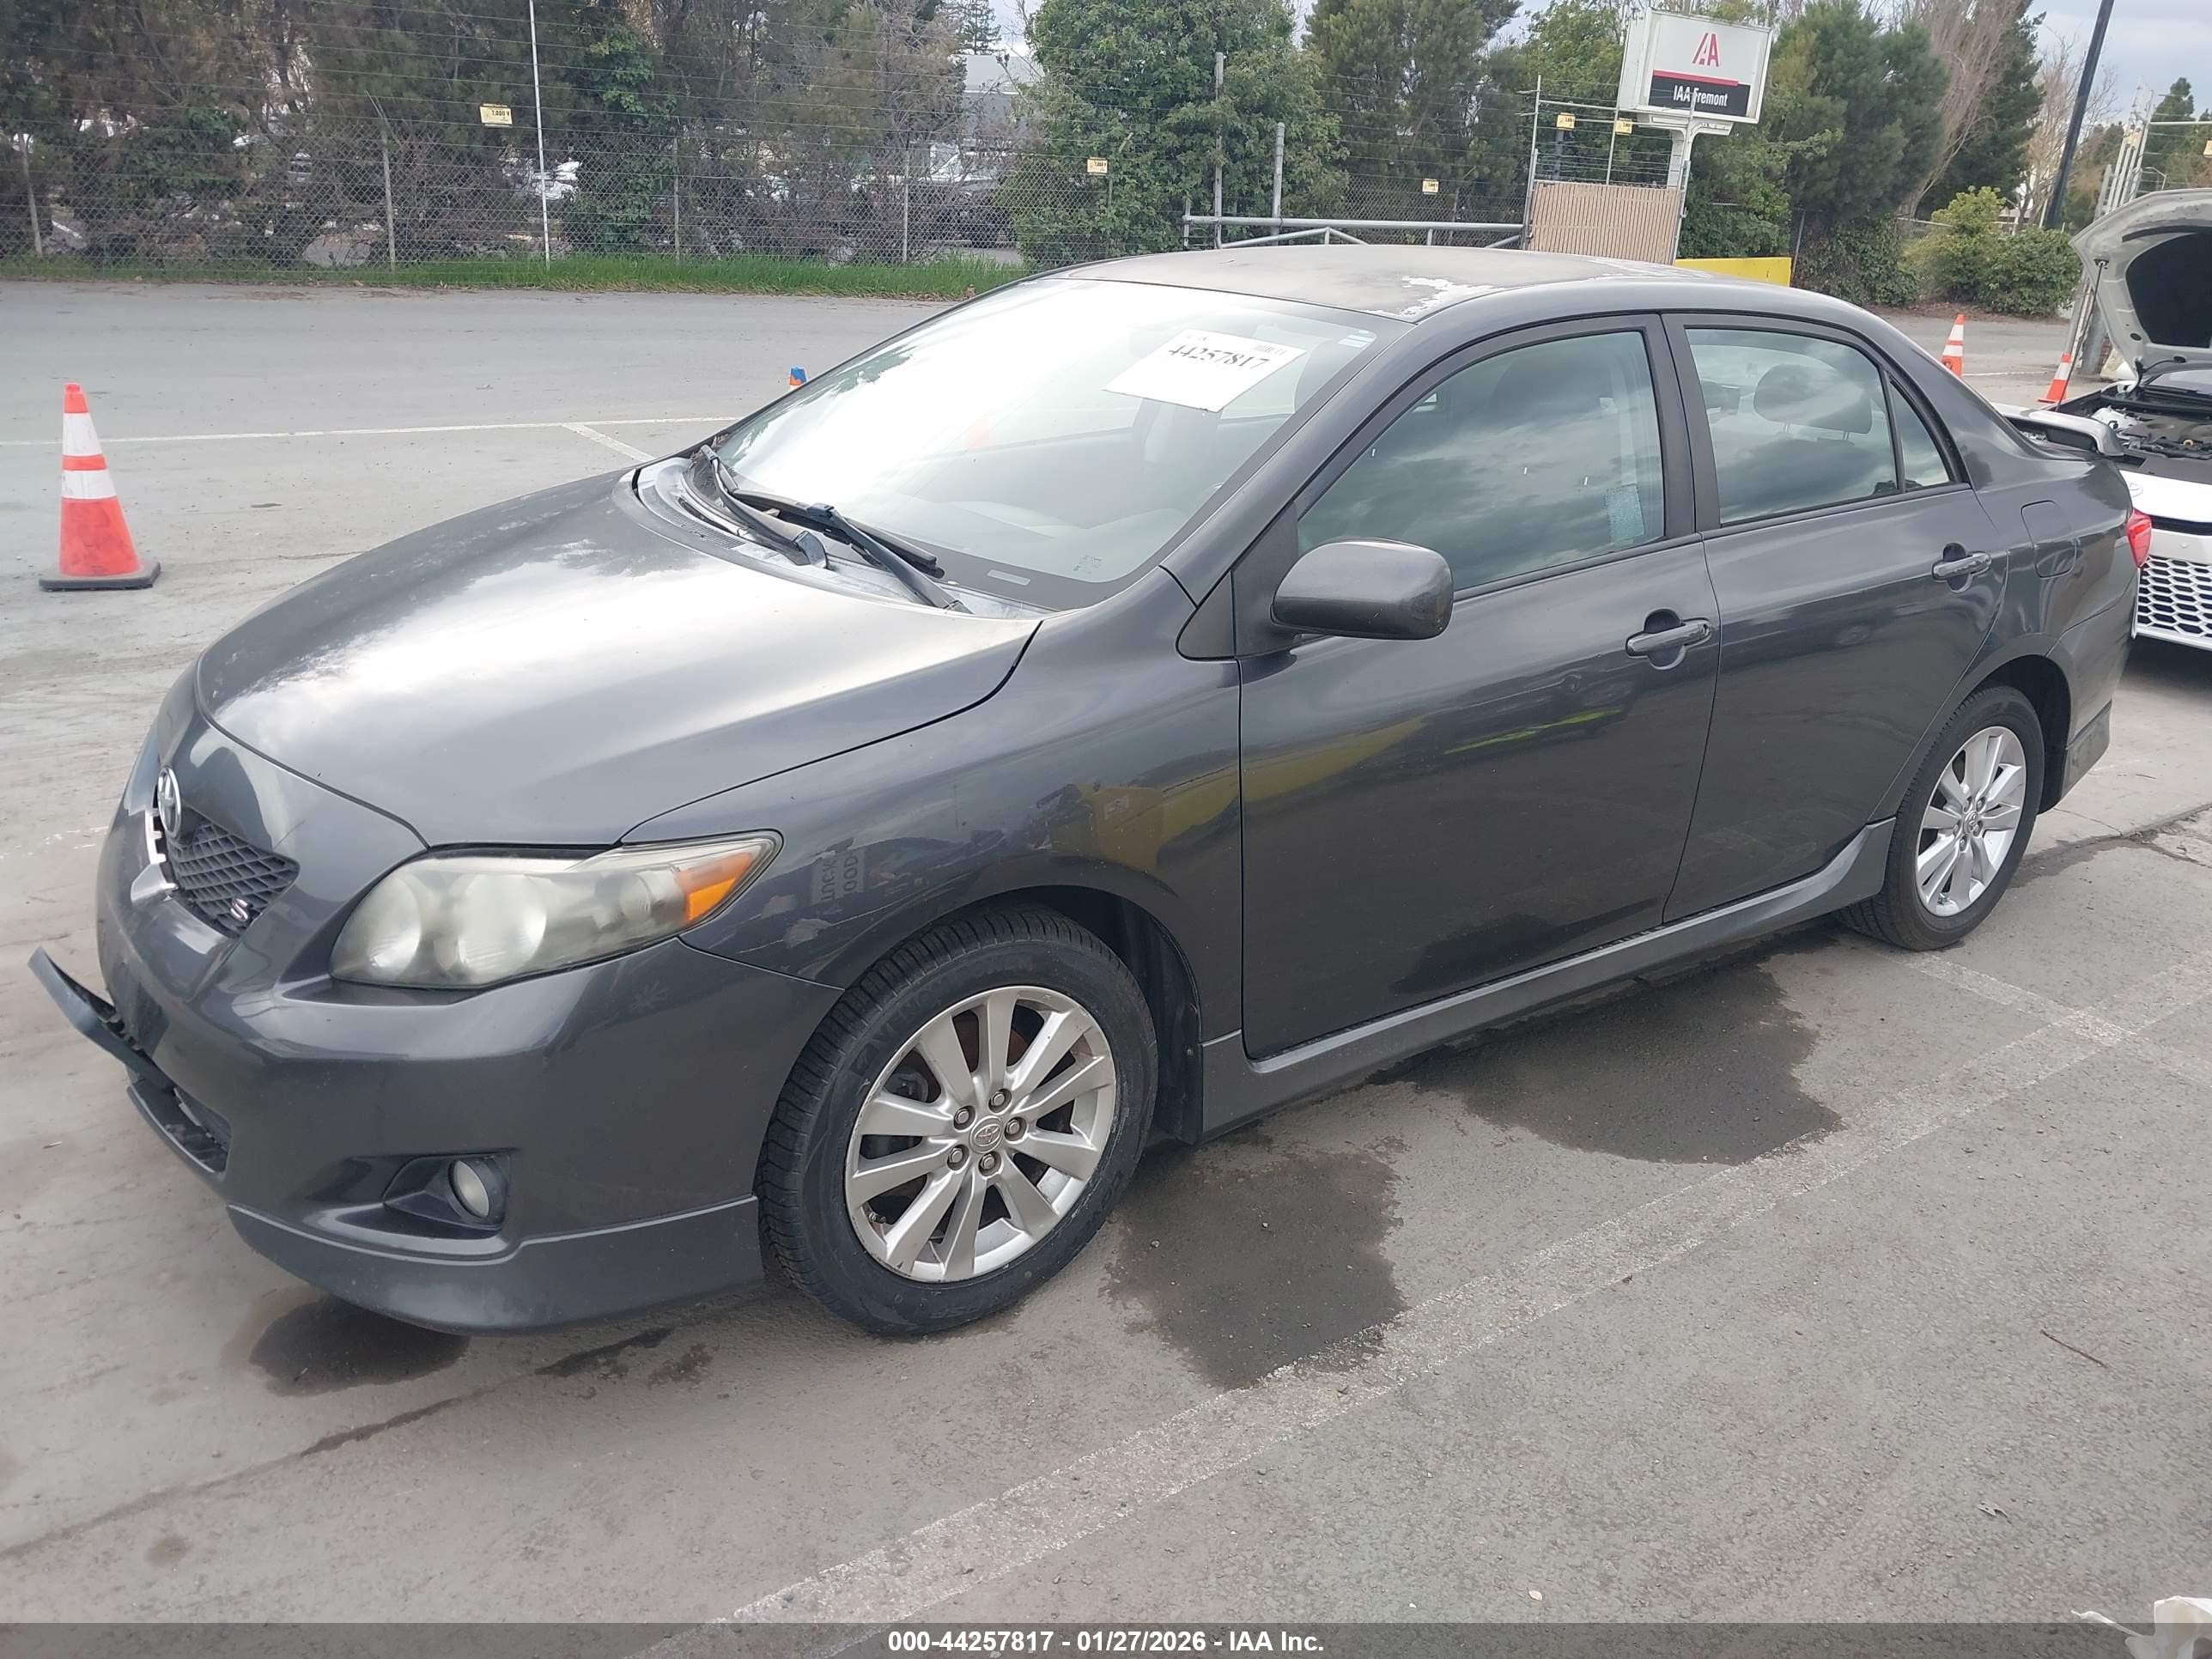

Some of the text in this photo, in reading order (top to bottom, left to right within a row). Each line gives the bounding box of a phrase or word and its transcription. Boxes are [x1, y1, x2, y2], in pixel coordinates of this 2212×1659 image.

[1674, 85, 1691, 102] IAA
[1169, 344, 1269, 368] 44257817
[231, 899, 248, 921] S
